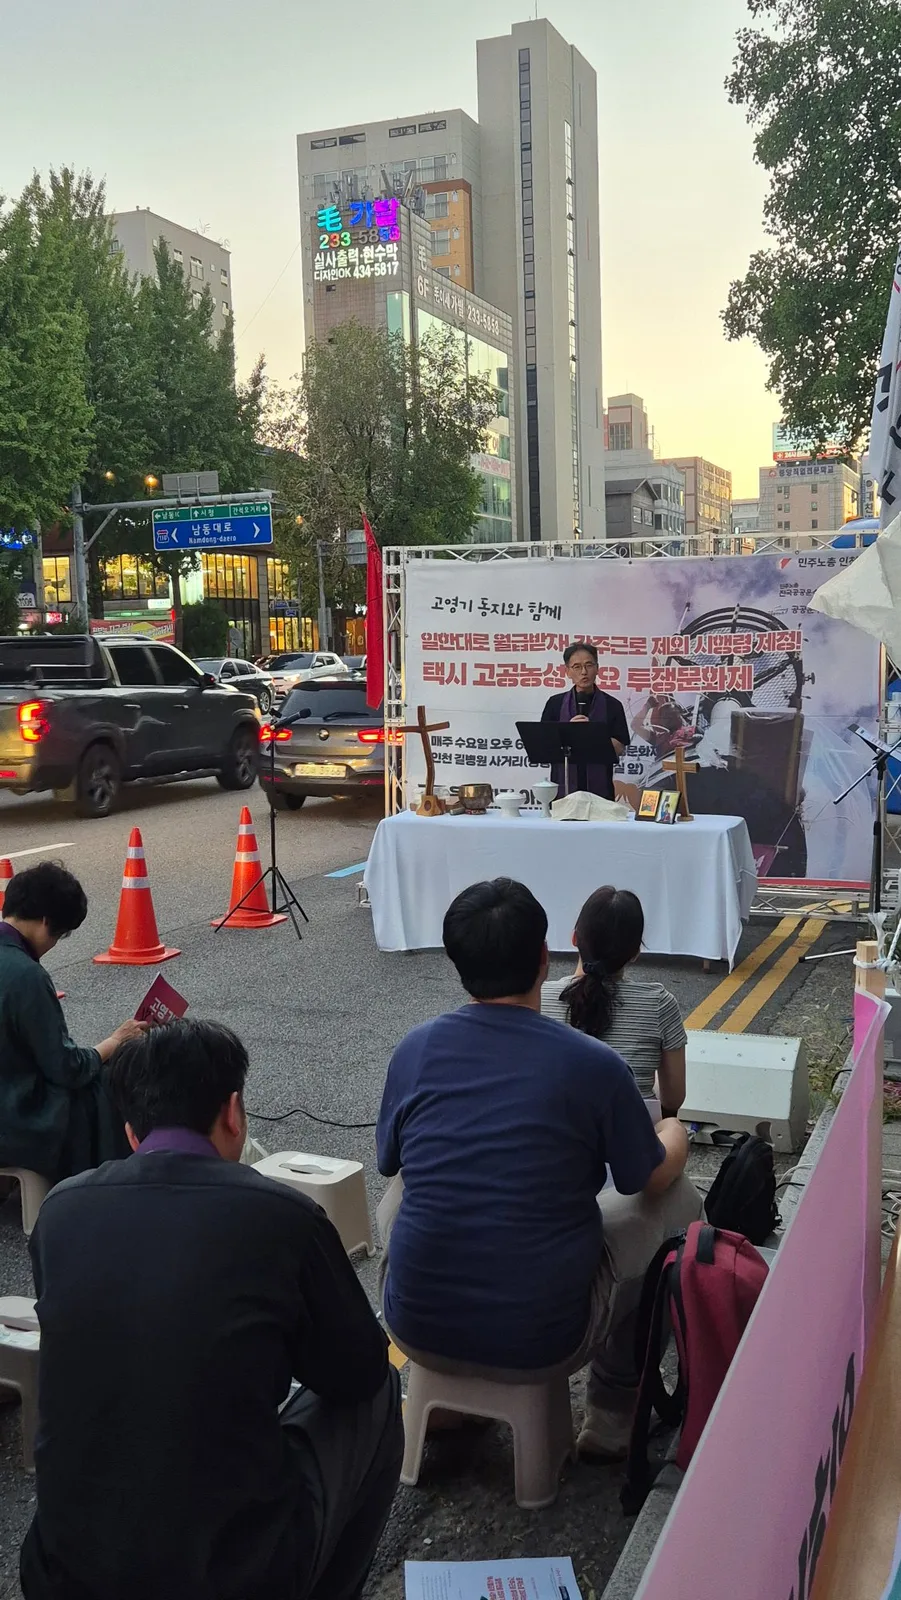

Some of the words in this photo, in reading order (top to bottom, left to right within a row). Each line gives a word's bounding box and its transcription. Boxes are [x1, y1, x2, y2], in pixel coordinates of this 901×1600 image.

[317, 205, 343, 232] 毛
[349, 197, 400, 228] 가발
[319, 225, 401, 250] 233-5858
[313, 267, 352, 282] 디자인OK
[352, 261, 399, 279] 434-5817
[417, 275, 430, 298] 6F
[233, 505, 261, 515] 간석오거리
[192, 522, 233, 536] 남동대로
[189, 535, 237, 545] Namdong-daero
[798, 557, 836, 567] 민주노총
[431, 596, 473, 613] 고영기
[477, 598, 523, 616] 동지와
[528, 602, 562, 621] 함께
[421, 632, 490, 651] 일한대로
[651, 635, 690, 655] 제외
[693, 632, 752, 655] 시행령
[754, 630, 802, 652] 제정!
[422, 662, 467, 686] 택시
[472, 663, 567, 688] 고공농성
[626, 665, 754, 692] 투쟁문화제
[431, 735, 453, 747] 매주
[454, 736, 488, 749] 수요일
[489, 738, 513, 750] 오후
[431, 752, 453, 765] 인천
[453, 753, 487, 767] 길병원
